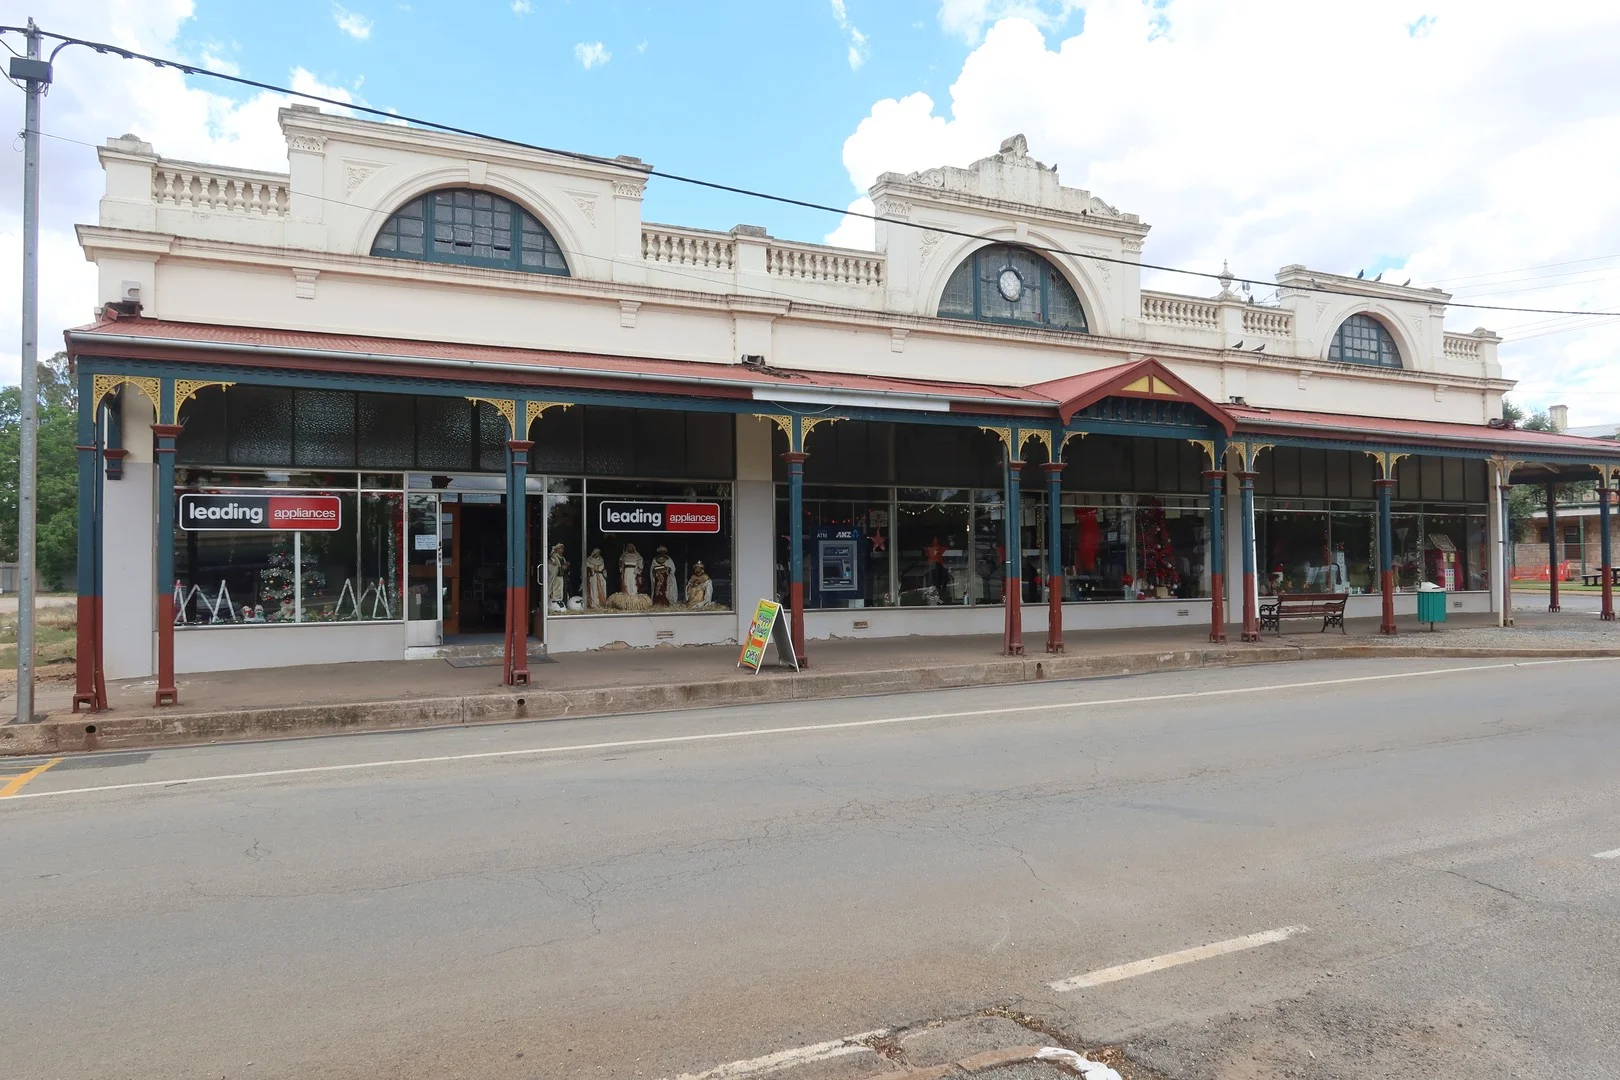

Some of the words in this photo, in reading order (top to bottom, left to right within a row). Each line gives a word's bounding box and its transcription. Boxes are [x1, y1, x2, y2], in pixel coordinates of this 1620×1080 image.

[189, 502, 263, 524] leading
[274, 507, 336, 520] appliances
[607, 507, 662, 527] leading
[669, 513, 716, 524] appliances
[835, 531, 852, 539] ANZ
